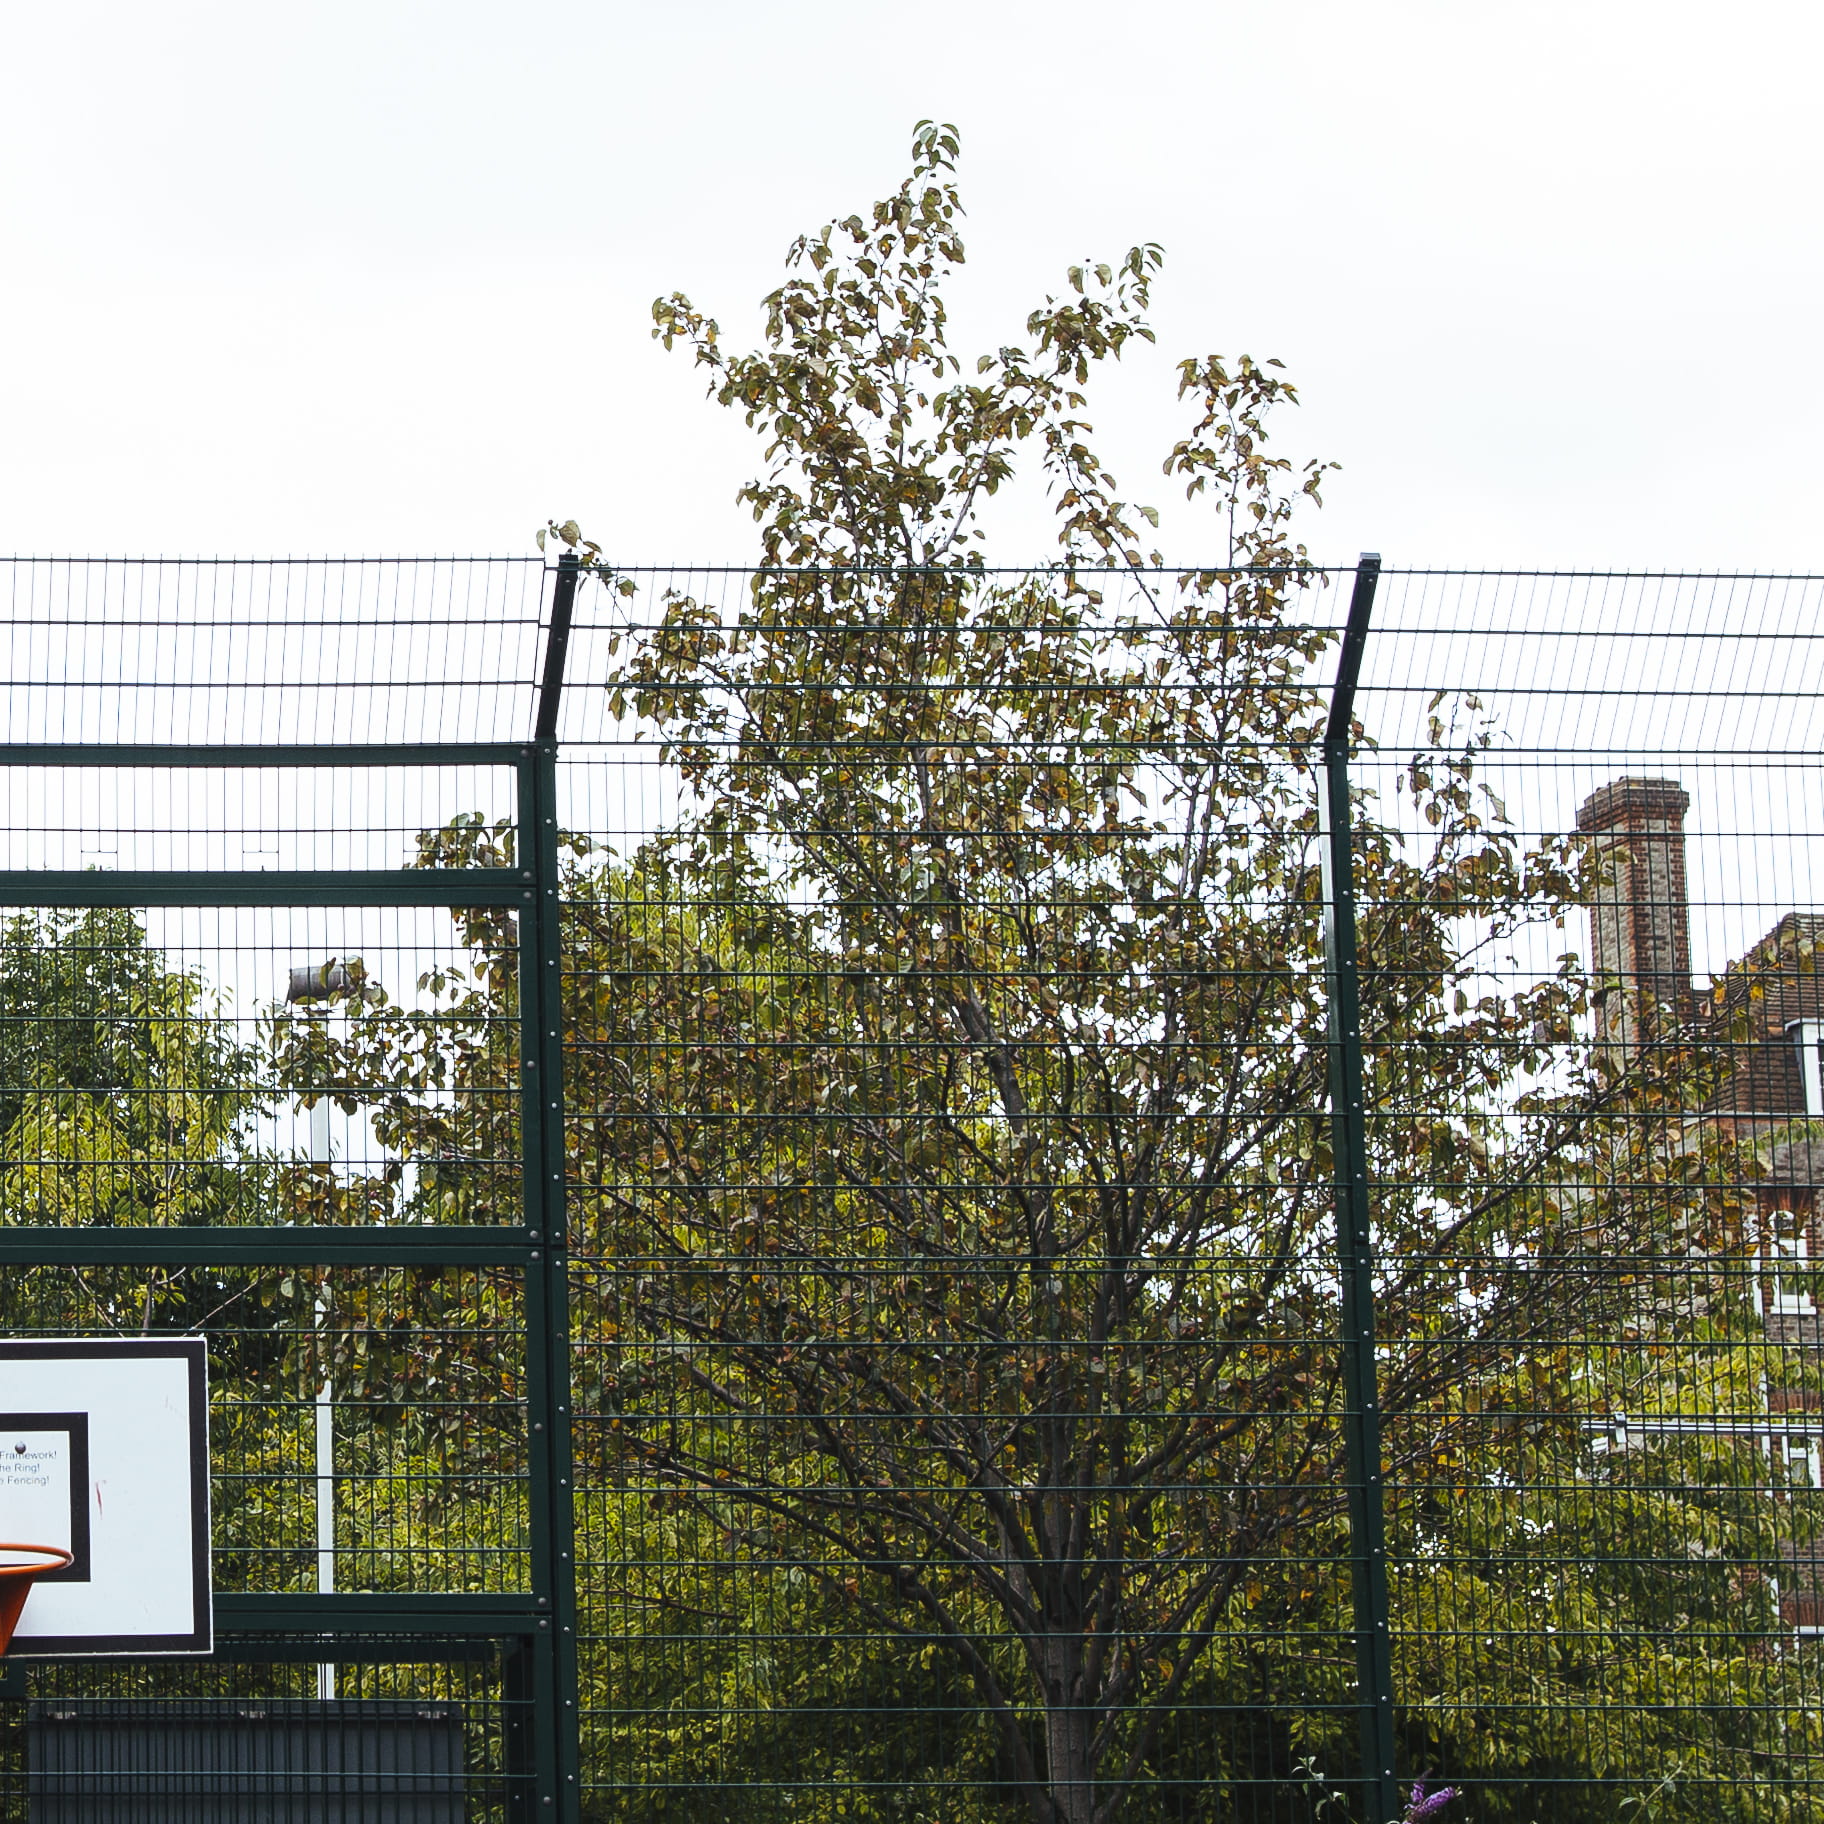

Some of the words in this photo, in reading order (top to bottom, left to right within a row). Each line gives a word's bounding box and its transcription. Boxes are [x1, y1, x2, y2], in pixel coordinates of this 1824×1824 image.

[0, 1451, 57, 1461] Framework!
[14, 1464, 41, 1475] Ring!
[7, 1476, 50, 1486] Fencing!
